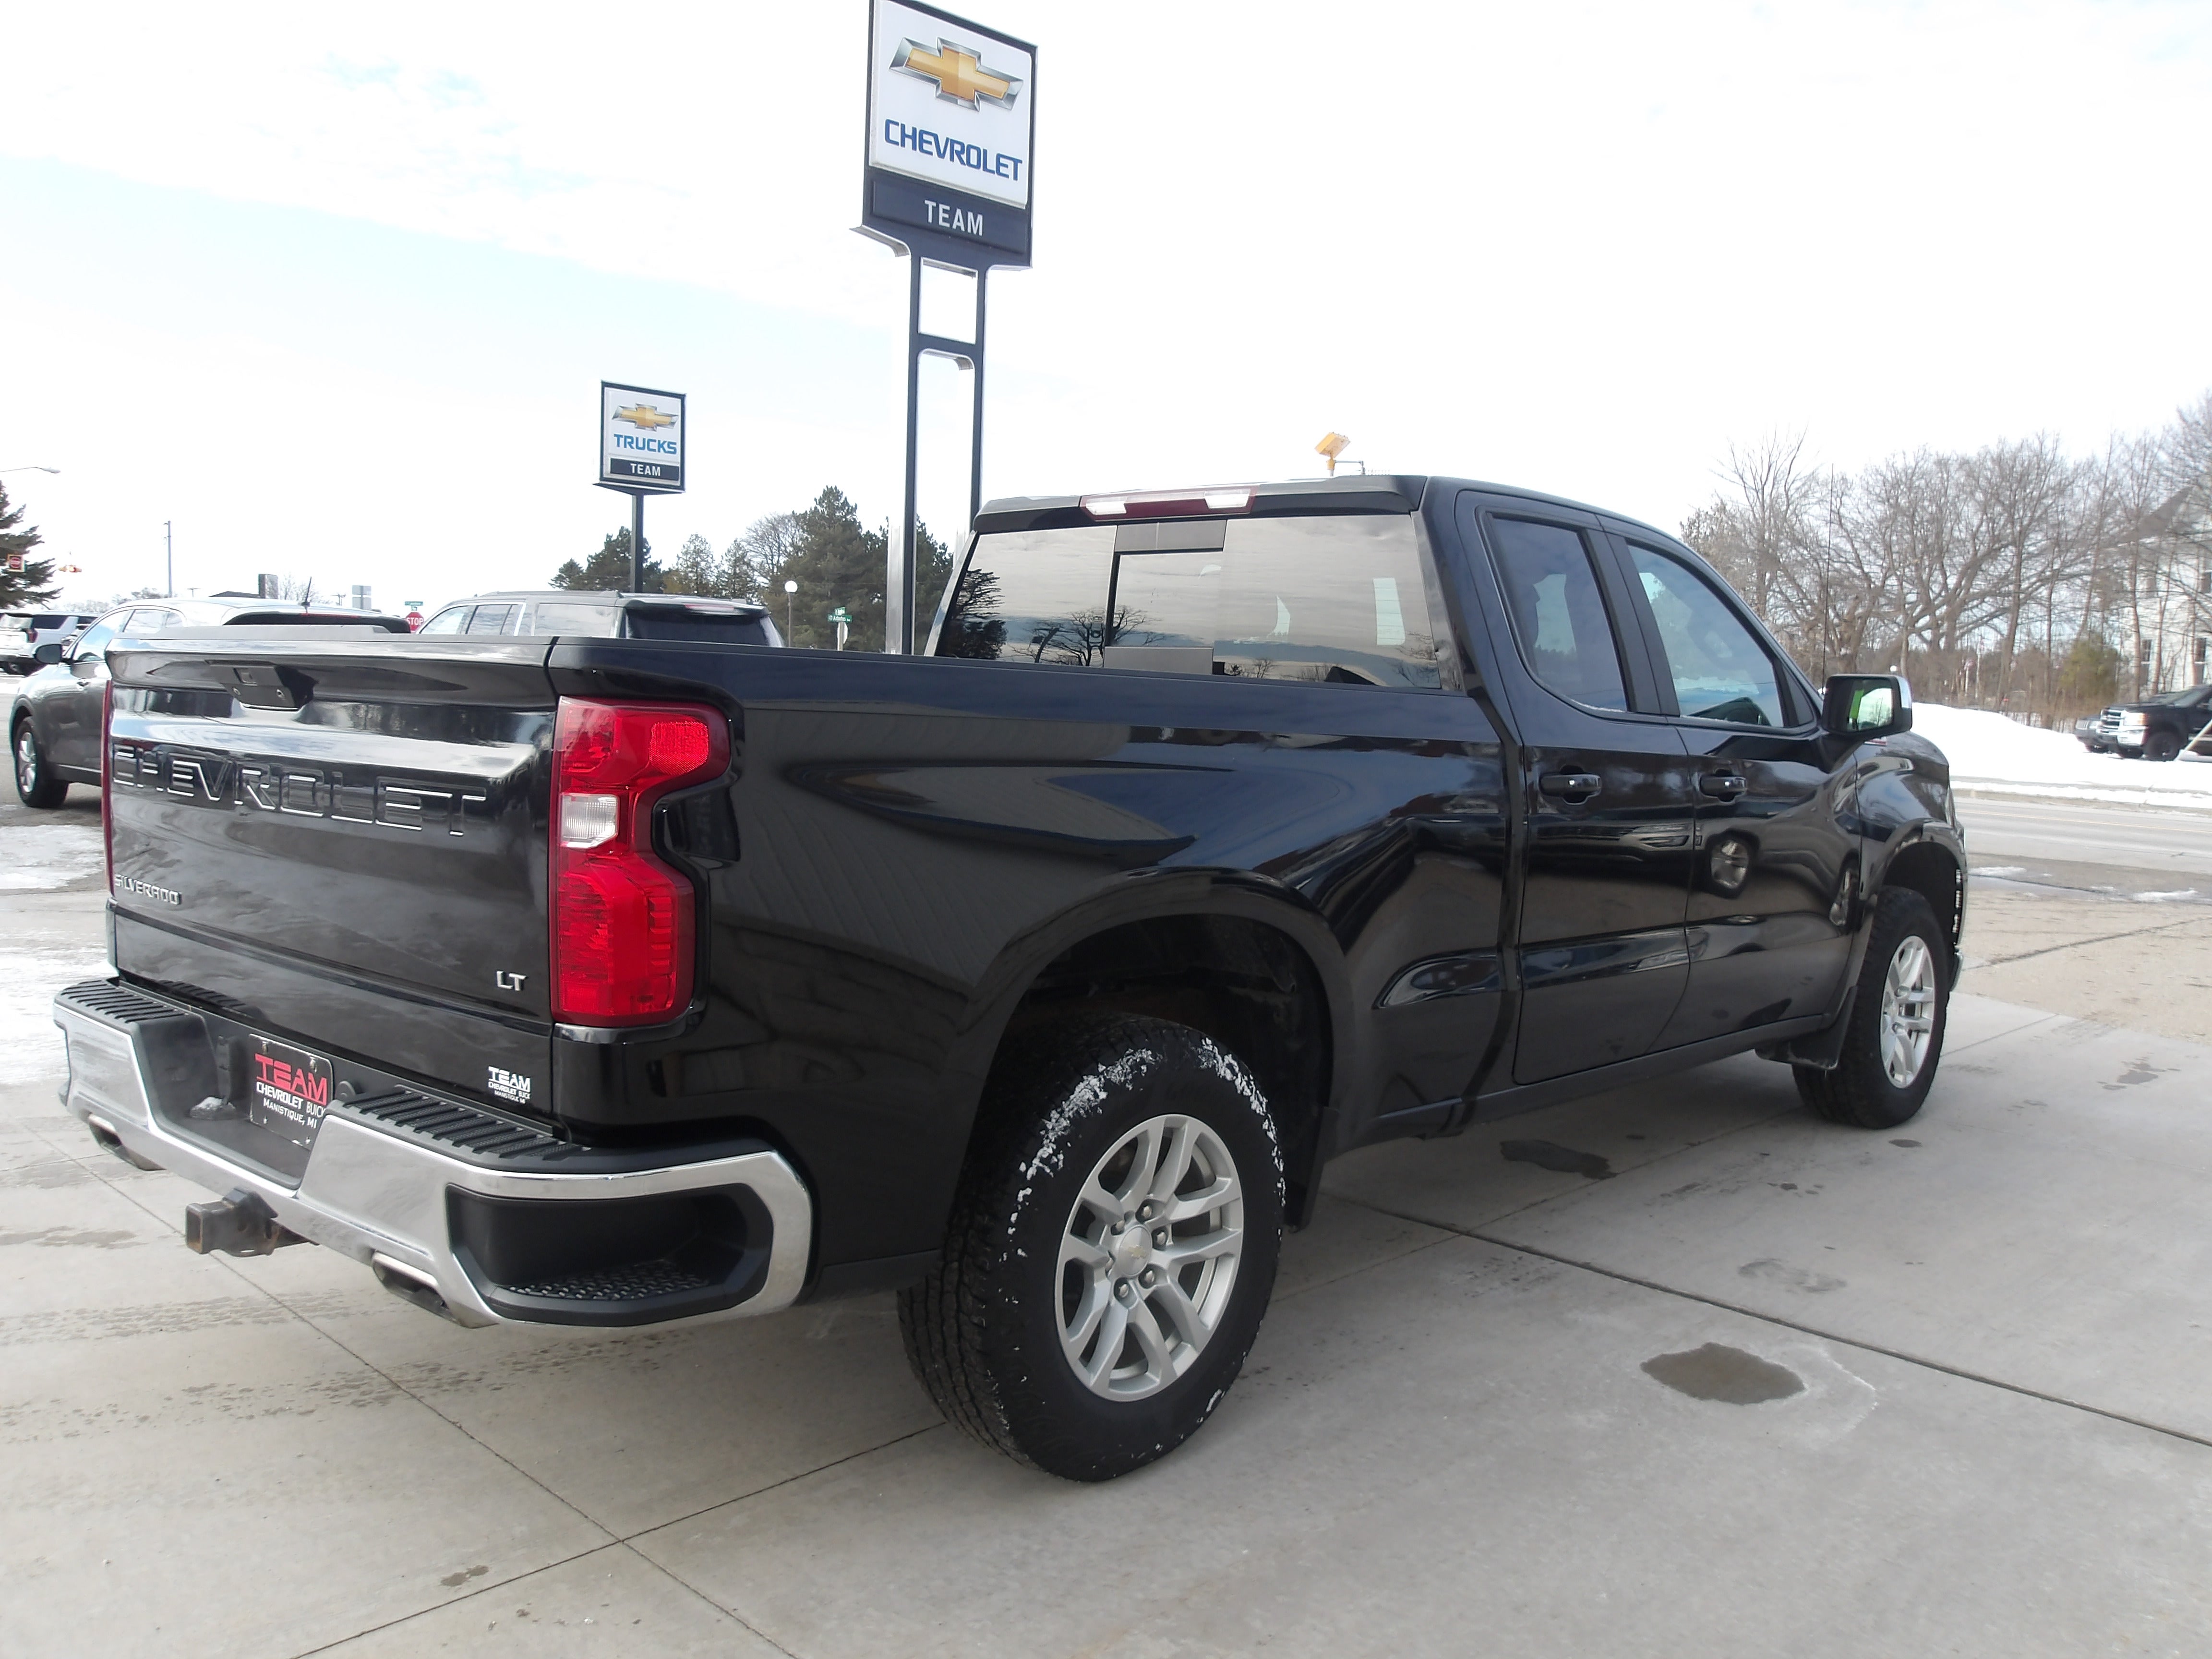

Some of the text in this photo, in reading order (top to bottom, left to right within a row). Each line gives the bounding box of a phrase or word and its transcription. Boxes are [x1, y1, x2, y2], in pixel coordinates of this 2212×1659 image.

[885, 119, 1022, 181] CHEVROLET
[924, 200, 983, 236] TEAM
[613, 433, 677, 455] TRUCKS
[630, 463, 661, 476] TEAM
[406, 617, 423, 625] STOP
[113, 744, 487, 836] CHEVROLET
[114, 874, 182, 905] SILVERADO
[496, 970, 527, 991] LT
[254, 1053, 327, 1106] TEAM
[488, 1066, 530, 1093] TEAM
[256, 1081, 304, 1109] CHEVROLET
[264, 1097, 318, 1129] MANISTIQUE, MI
